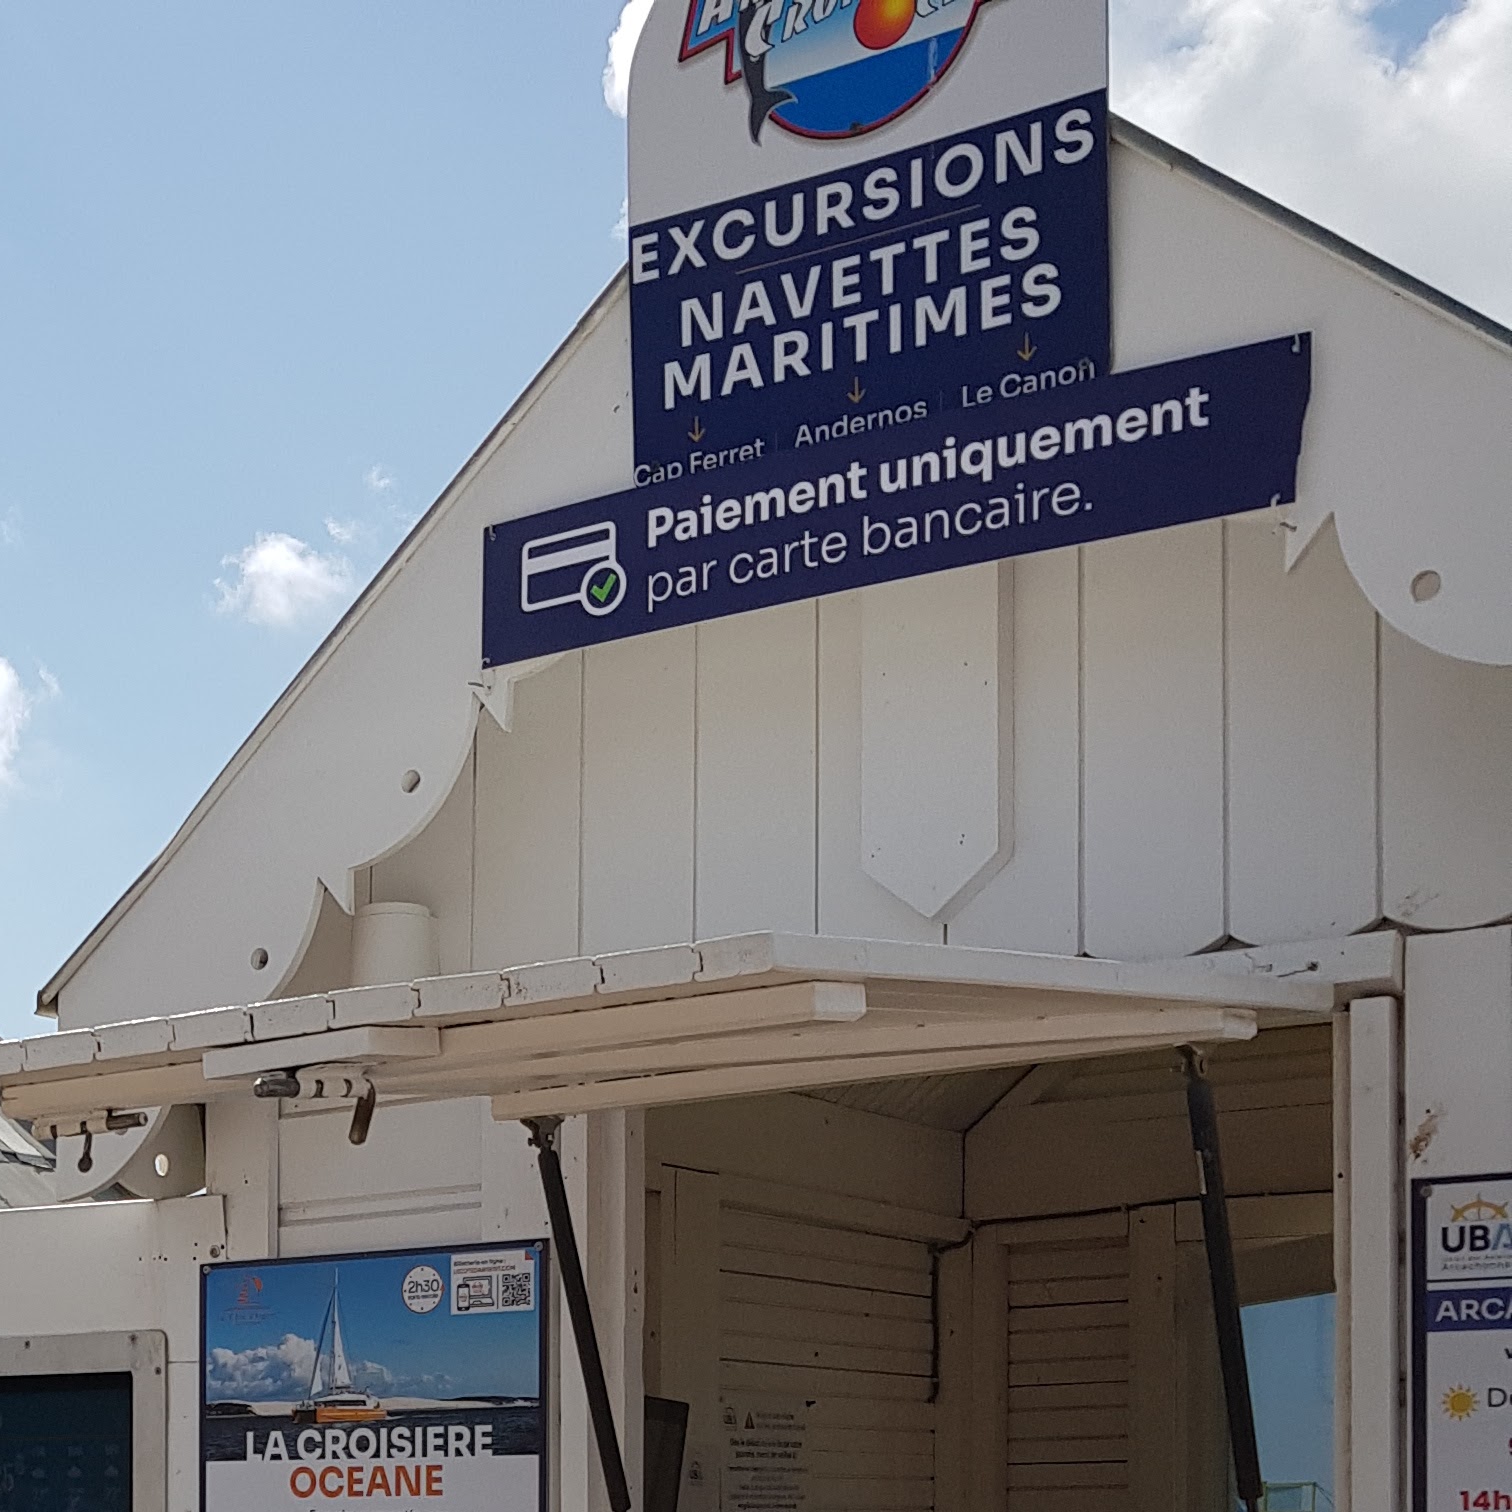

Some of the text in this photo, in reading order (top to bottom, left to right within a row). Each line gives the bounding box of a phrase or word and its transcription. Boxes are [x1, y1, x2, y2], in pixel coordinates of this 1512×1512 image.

[632, 108, 1094, 284] EXCURSIONS
[664, 263, 1063, 410] MARITIMES
[681, 206, 1040, 347] NAVETTES
[647, 386, 1211, 548] Paiement uniquement
[688, 436, 767, 474] Ferret
[794, 400, 929, 450] Andernos
[961, 378, 993, 409] Le
[999, 358, 1098, 399] Canon
[647, 482, 1094, 612] par carte bancaire.
[407, 1278, 441, 1295] 2h30
[245, 1424, 494, 1462] LA CROISIERE
[289, 1464, 444, 1499] OCEANE
[1459, 1490, 1512, 1511] 14h
